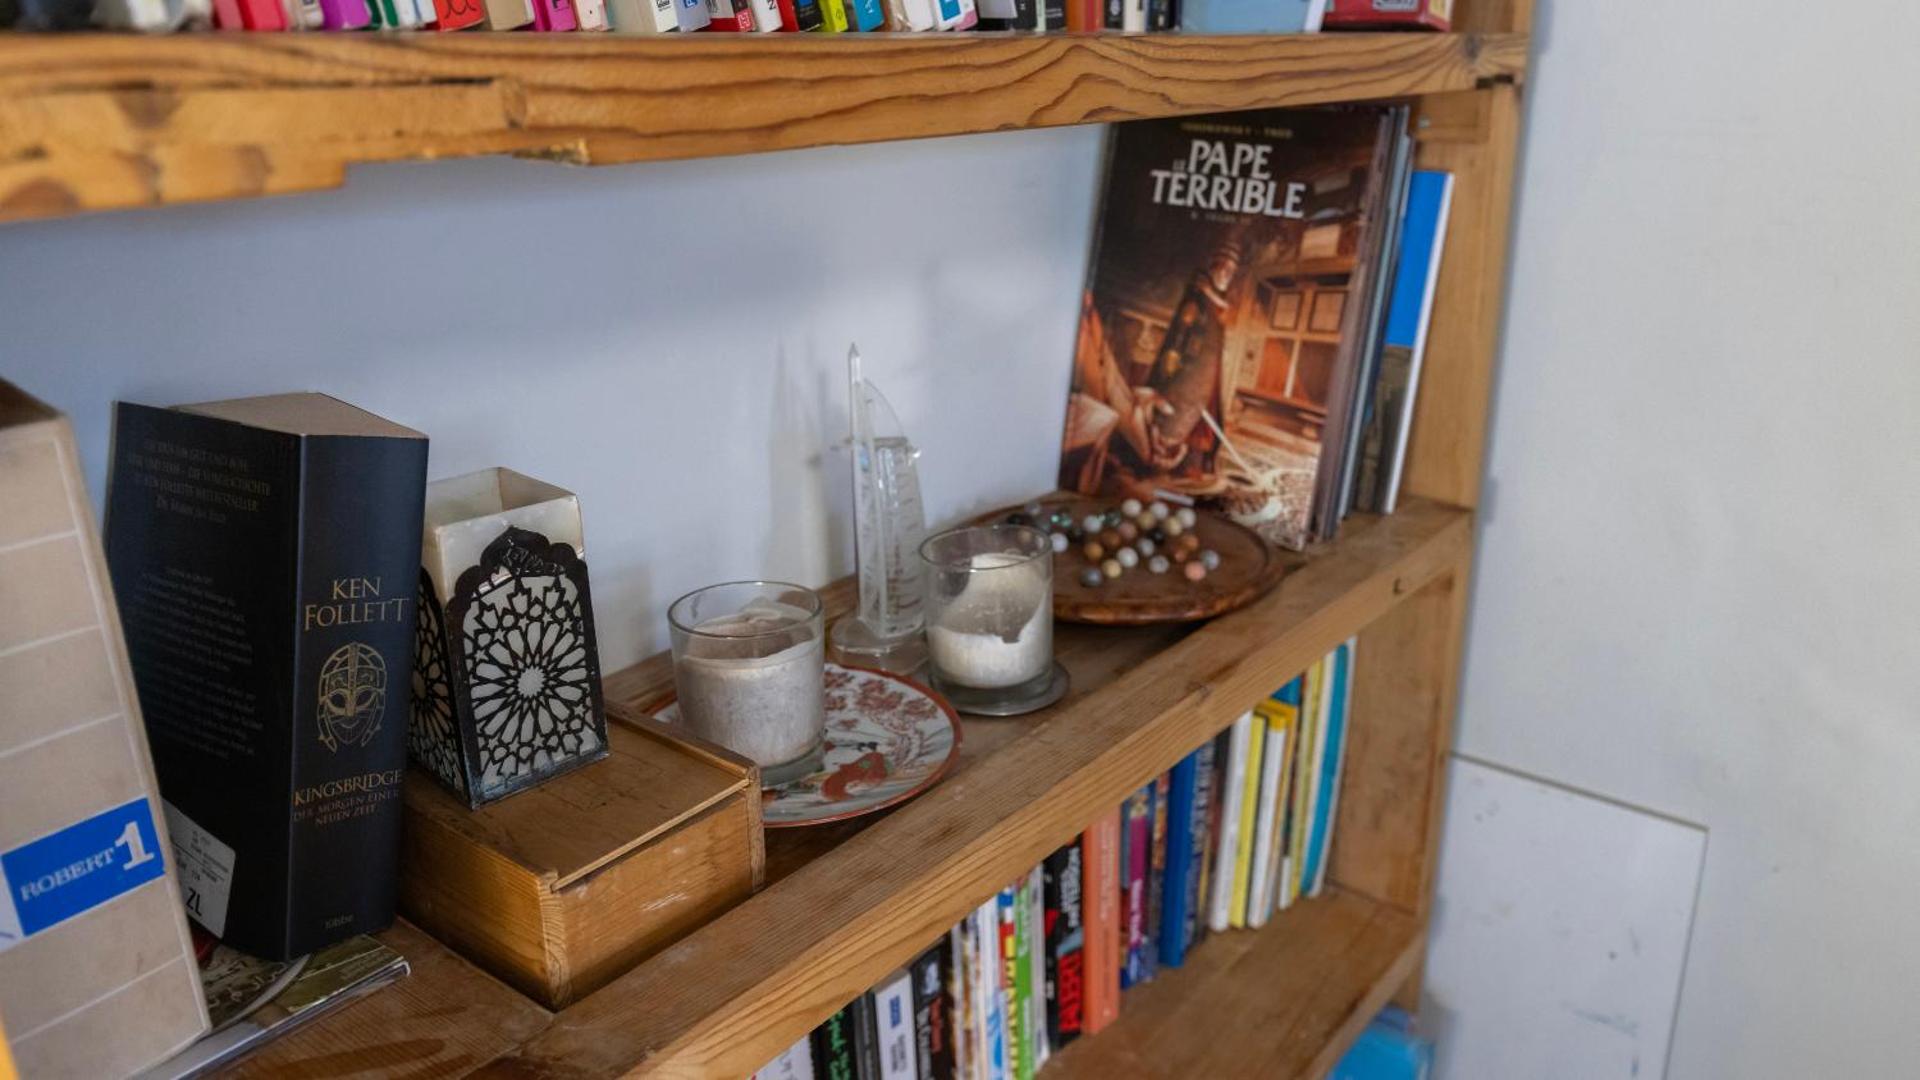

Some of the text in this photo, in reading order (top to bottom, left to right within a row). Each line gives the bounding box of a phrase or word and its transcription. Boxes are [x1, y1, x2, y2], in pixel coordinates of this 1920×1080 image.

[1187, 138, 1273, 181] PAPE
[1150, 169, 1307, 220] TERRIBLE
[332, 577, 381, 600] KEN
[304, 598, 409, 631] FOLLETT
[292, 768, 402, 807] KINGSBRIDGE
[353, 803, 377, 817] ZEIT
[20, 847, 115, 901] ROBERT
[115, 821, 155, 871] 1
